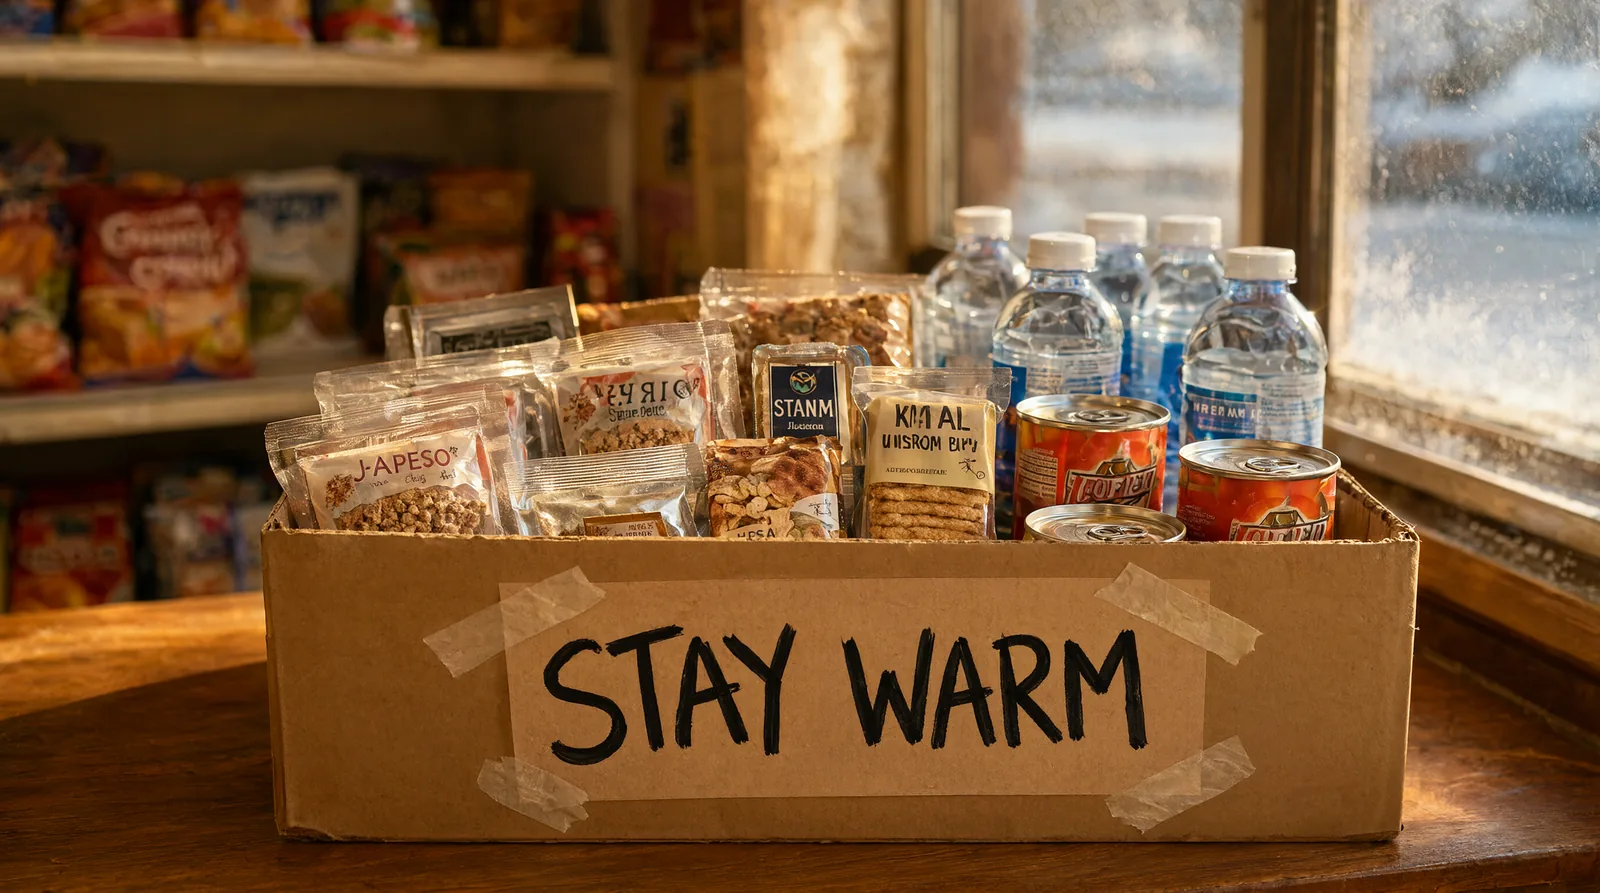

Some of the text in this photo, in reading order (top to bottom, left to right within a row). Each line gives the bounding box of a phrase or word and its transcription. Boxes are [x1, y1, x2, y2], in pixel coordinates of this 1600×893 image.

[774, 399, 834, 418] STANM
[543, 623, 1149, 766] STAY WARM
